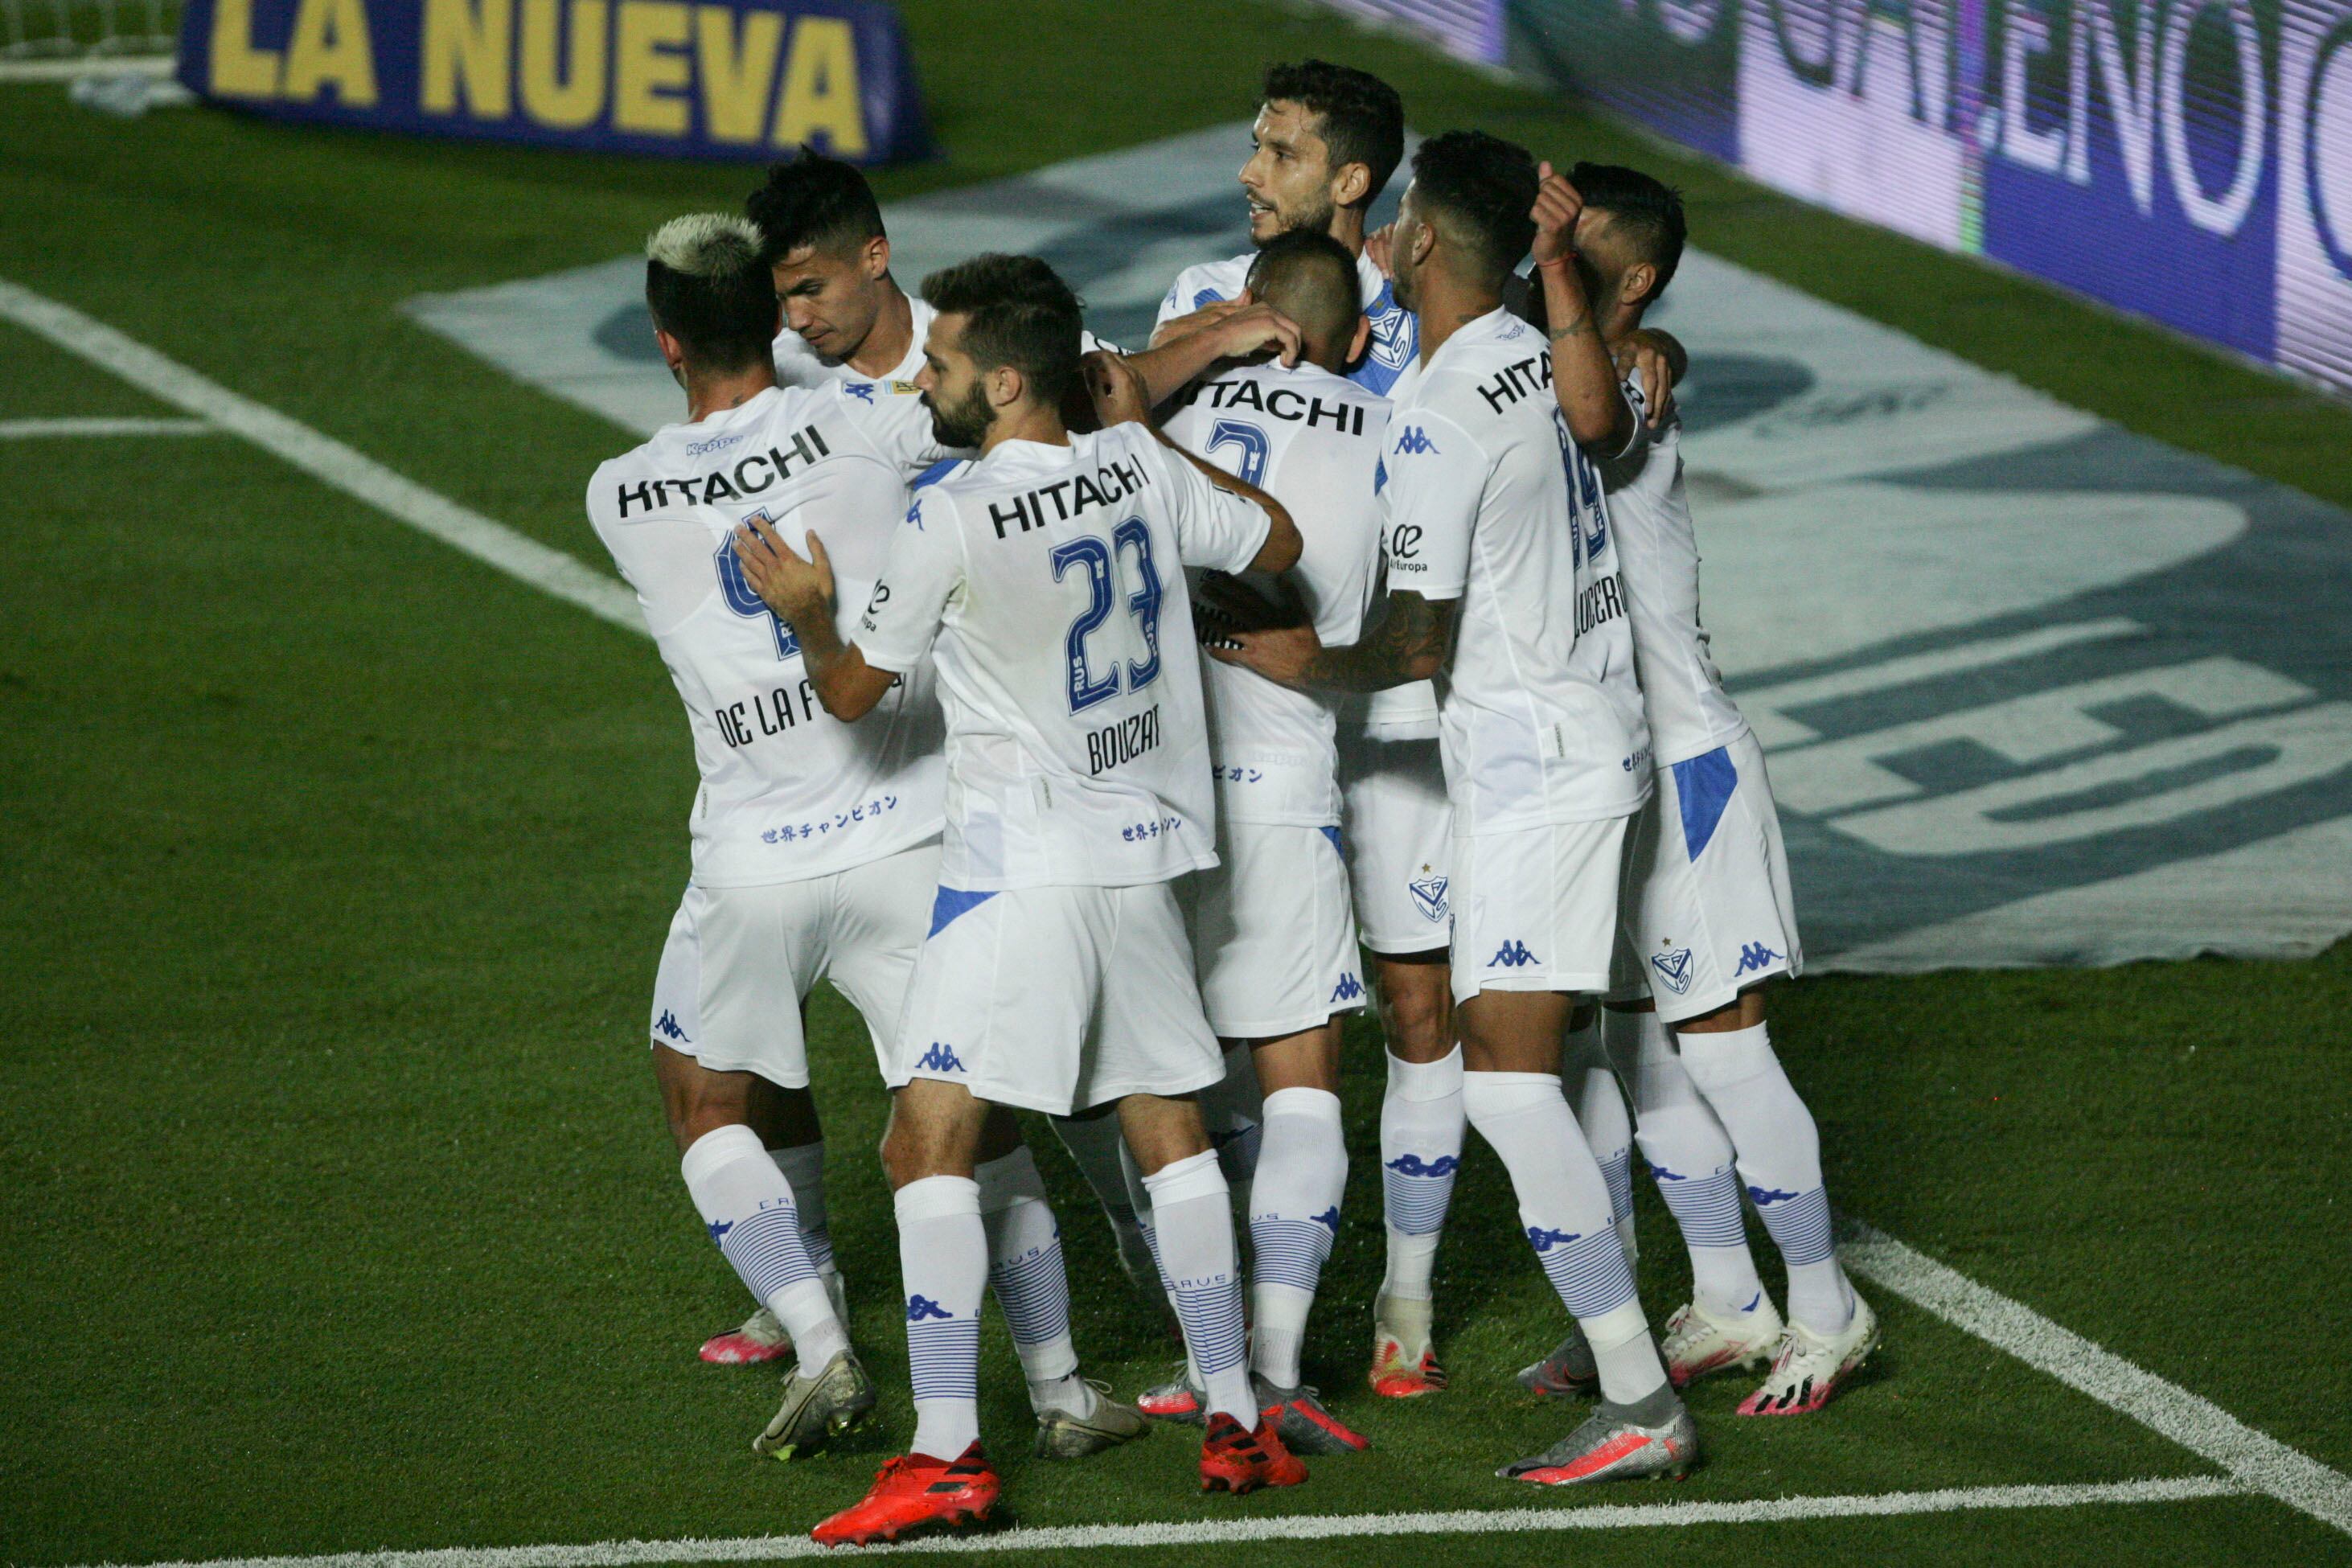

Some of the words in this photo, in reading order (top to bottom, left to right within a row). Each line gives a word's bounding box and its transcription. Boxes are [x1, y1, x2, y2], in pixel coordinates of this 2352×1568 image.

[207, 0, 380, 106] LA
[420, 0, 869, 154] NUEVA
[618, 425, 831, 519] HITACHI
[988, 454, 1151, 539] HITACHI
[1049, 515, 1164, 716] 23
[1073, 655, 1086, 692] RUS
[715, 701, 753, 748] DE
[753, 688, 795, 736] LA
[1086, 703, 1160, 776] BOUZAT
